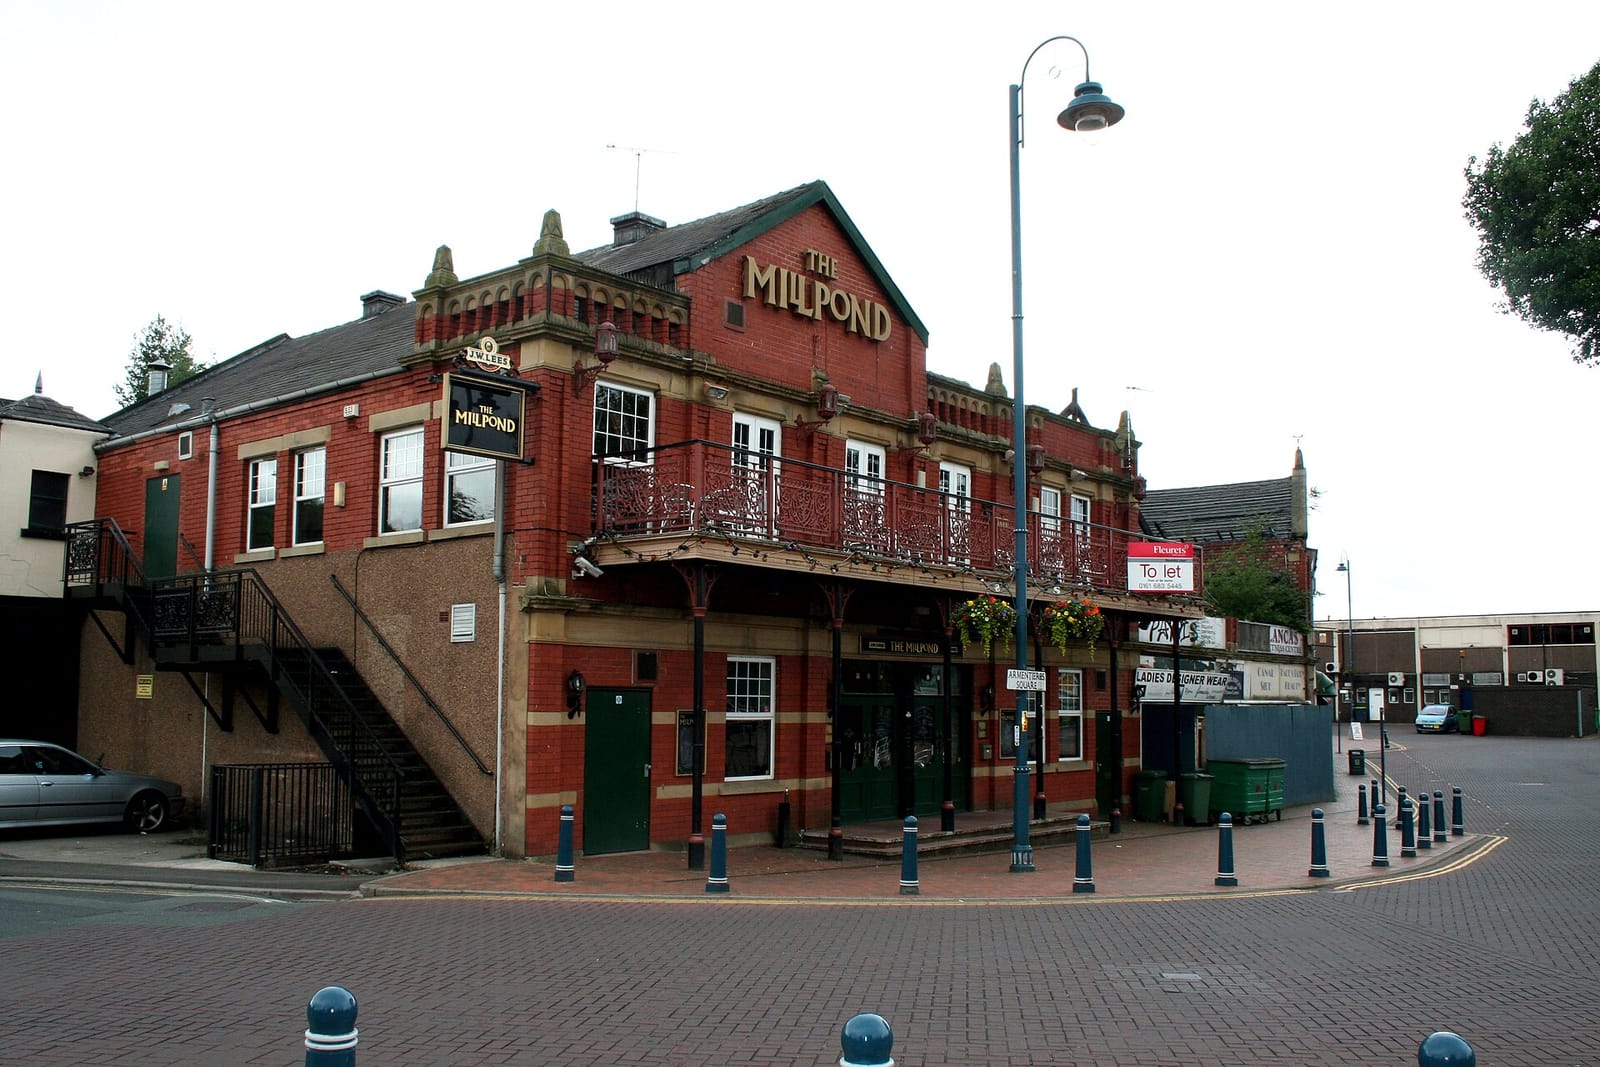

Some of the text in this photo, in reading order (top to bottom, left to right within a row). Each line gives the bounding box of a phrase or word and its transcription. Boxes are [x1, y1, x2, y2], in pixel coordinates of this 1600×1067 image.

[803, 248, 839, 280] THE
[742, 255, 892, 342] MILLPOND
[479, 405, 494, 415] THE
[455, 409, 516, 433] MILLPOND
[1152, 545, 1187, 554] Fleurets
[1139, 564, 1182, 578] To let
[890, 640, 905, 652] THE
[905, 641, 939, 654] MILLPOND
[1016, 681, 1038, 690] SQUARE
[1136, 671, 1165, 683] LADIES
[1166, 674, 1205, 686] DIGNER
[1206, 675, 1228, 687] WEAR
